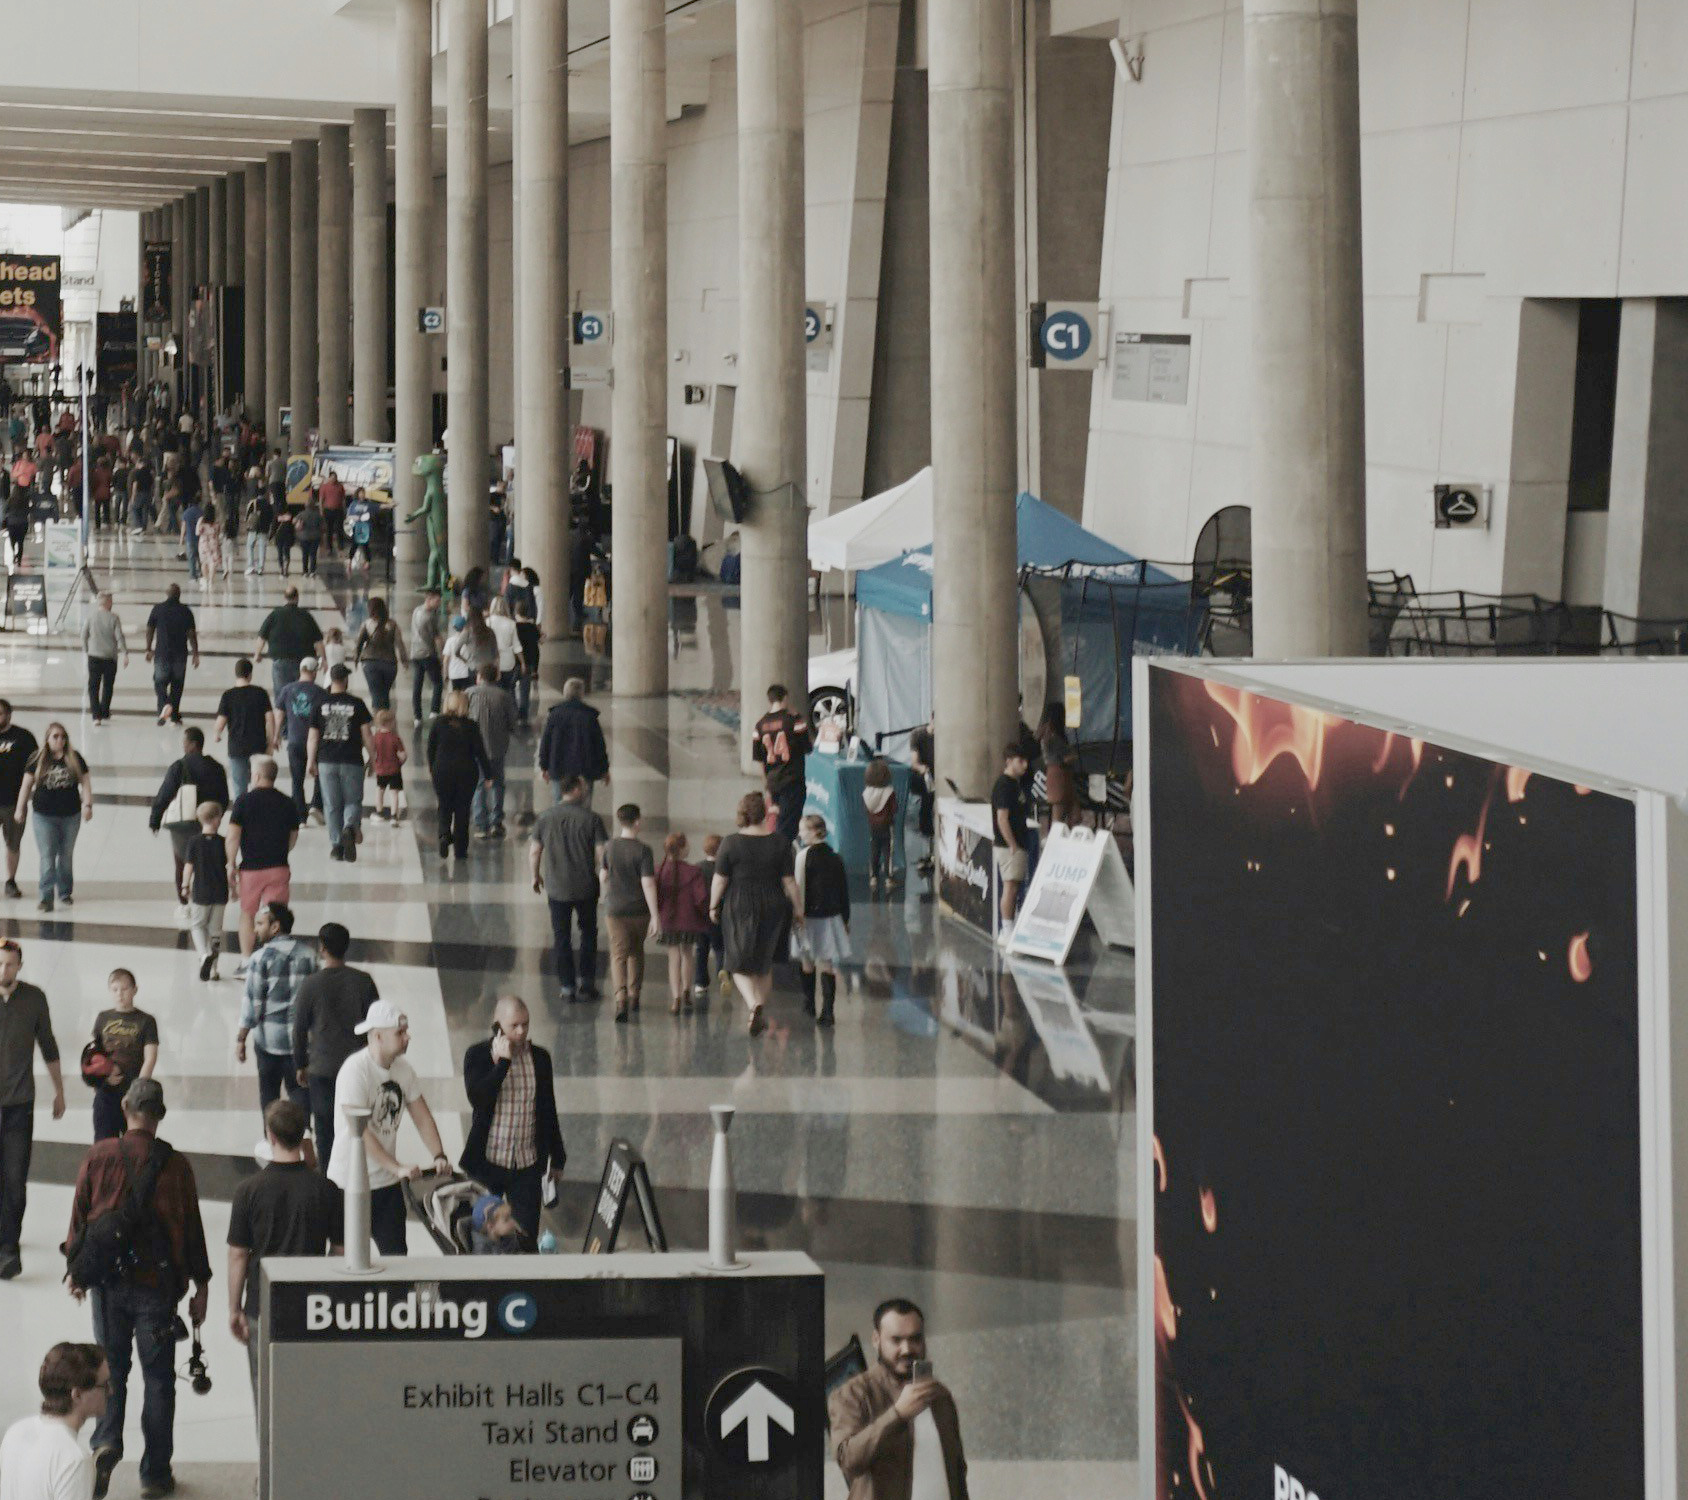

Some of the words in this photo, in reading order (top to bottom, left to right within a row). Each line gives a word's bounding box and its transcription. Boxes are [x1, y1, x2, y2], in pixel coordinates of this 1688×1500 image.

[62, 275, 95, 286] Stand
[582, 320, 599, 334] C1
[1046, 322, 1081, 350] C1
[1045, 863, 1087, 882] JUMP
[306, 1292, 488, 1337] Building
[505, 1299, 527, 1327] C
[404, 1384, 493, 1409] Exhibit
[506, 1383, 564, 1407] Halls
[483, 1422, 534, 1444] Taxi
[546, 1420, 618, 1444] Stand
[510, 1458, 616, 1482] Elevator
